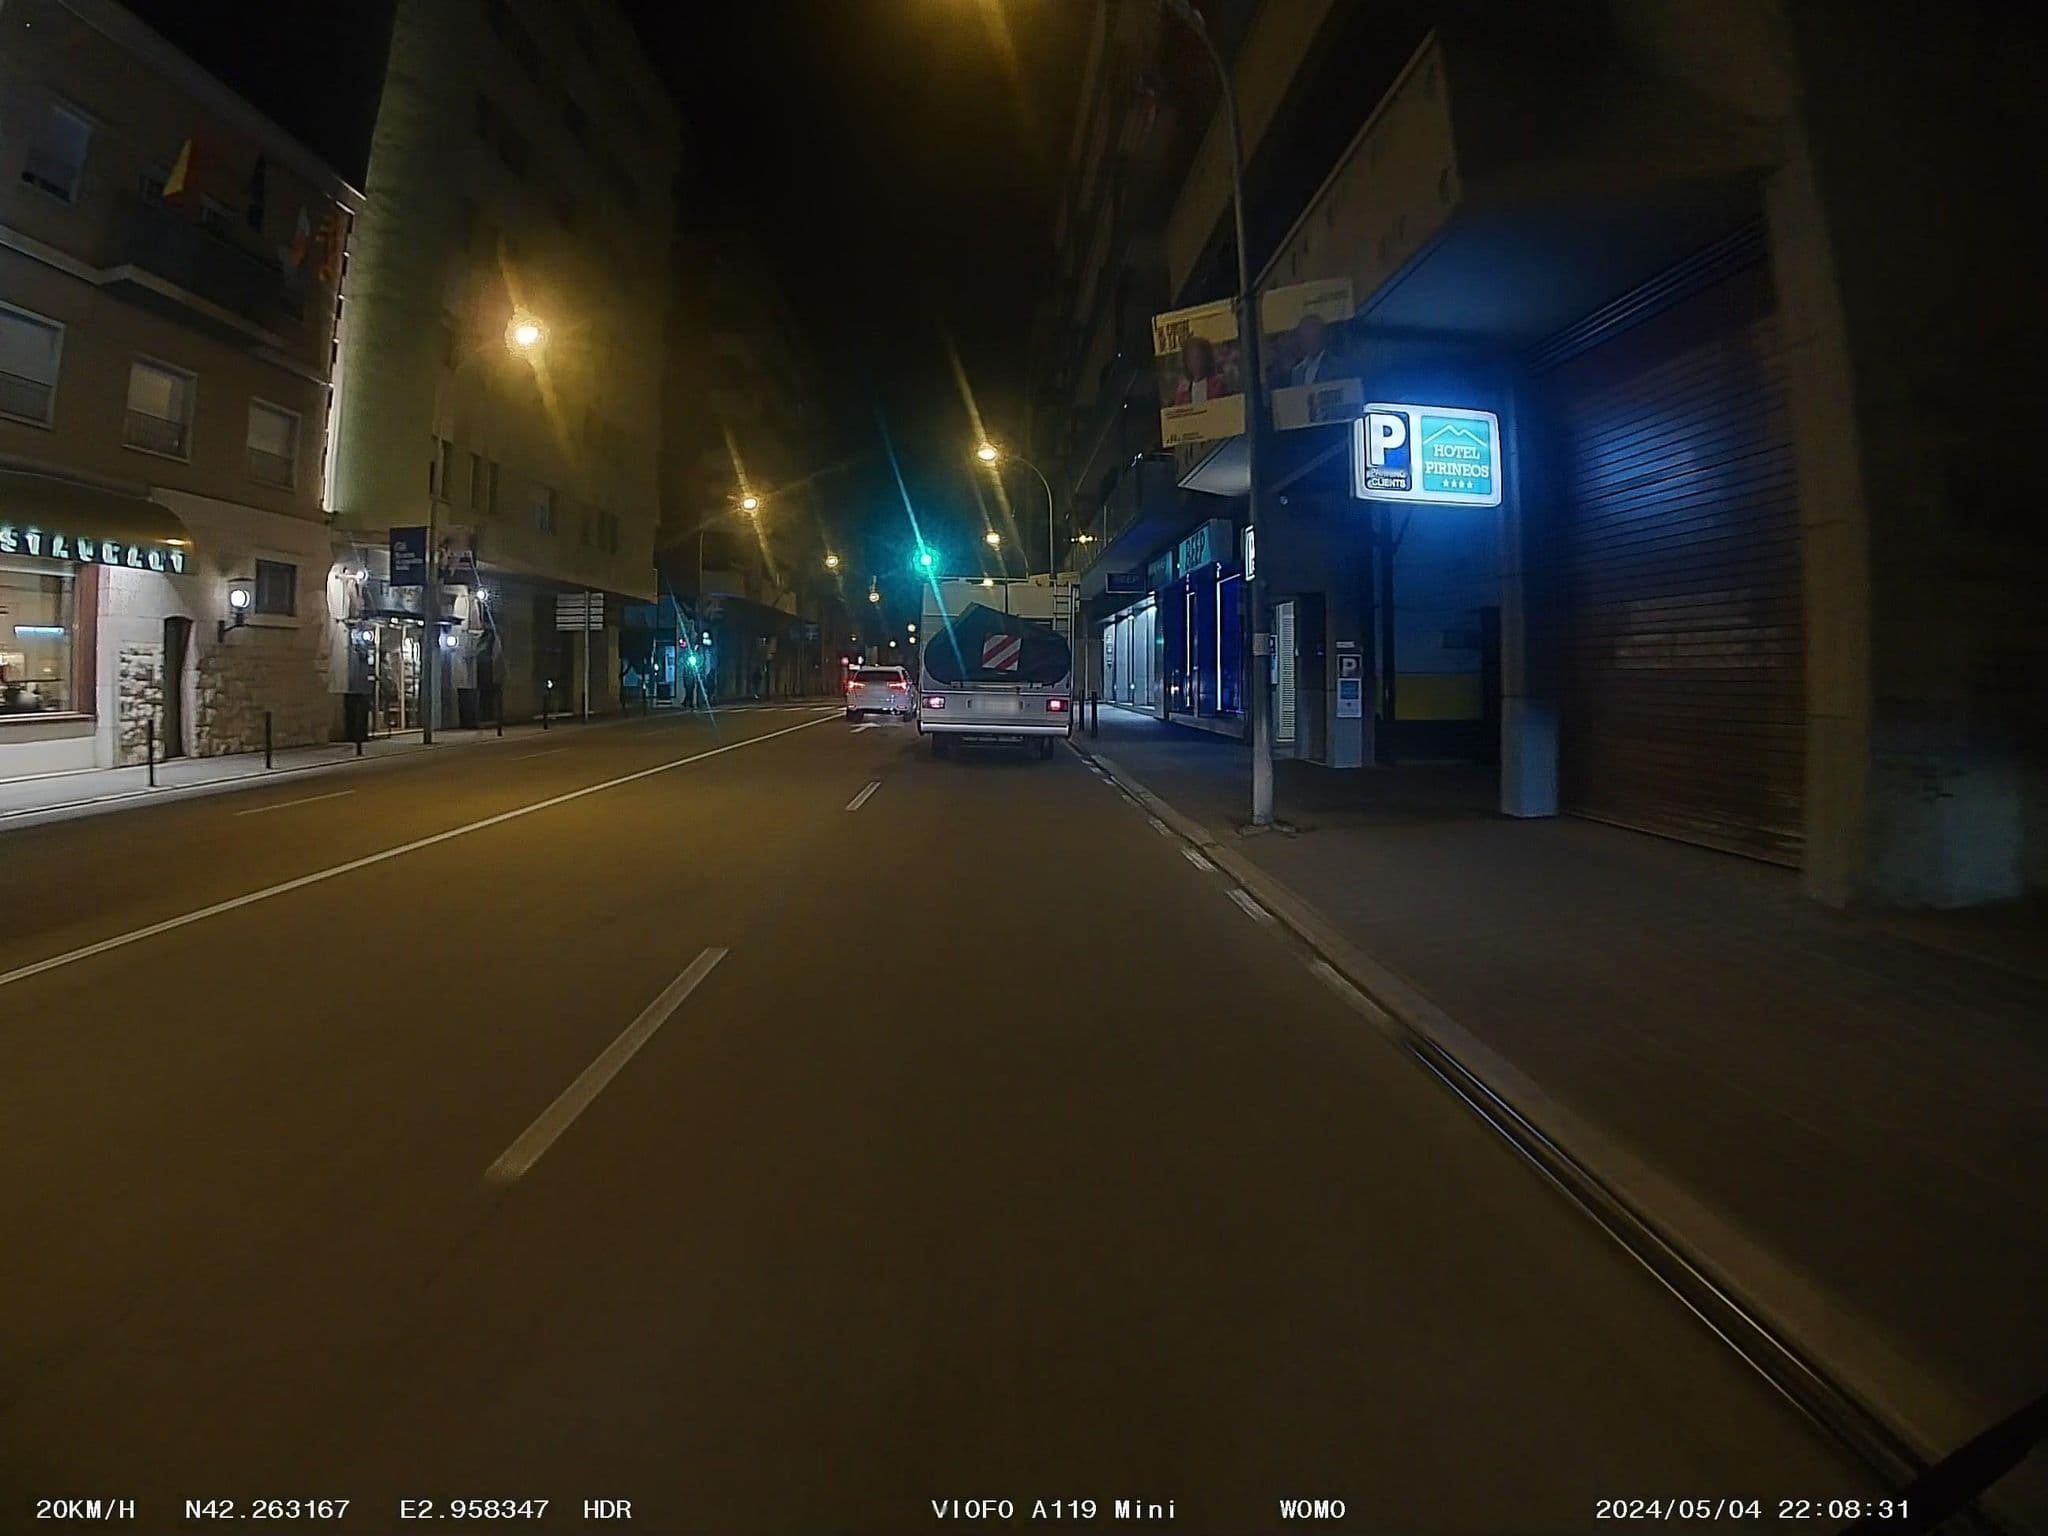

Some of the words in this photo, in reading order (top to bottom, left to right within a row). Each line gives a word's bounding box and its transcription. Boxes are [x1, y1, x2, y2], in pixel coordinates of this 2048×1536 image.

[1368, 413, 1406, 466] P
[1433, 443, 1480, 460] HOTEL
[1424, 461, 1489, 478] PIRINEOS
[1371, 477, 1406, 489] CLIENTS
[1342, 658, 1357, 678] P
